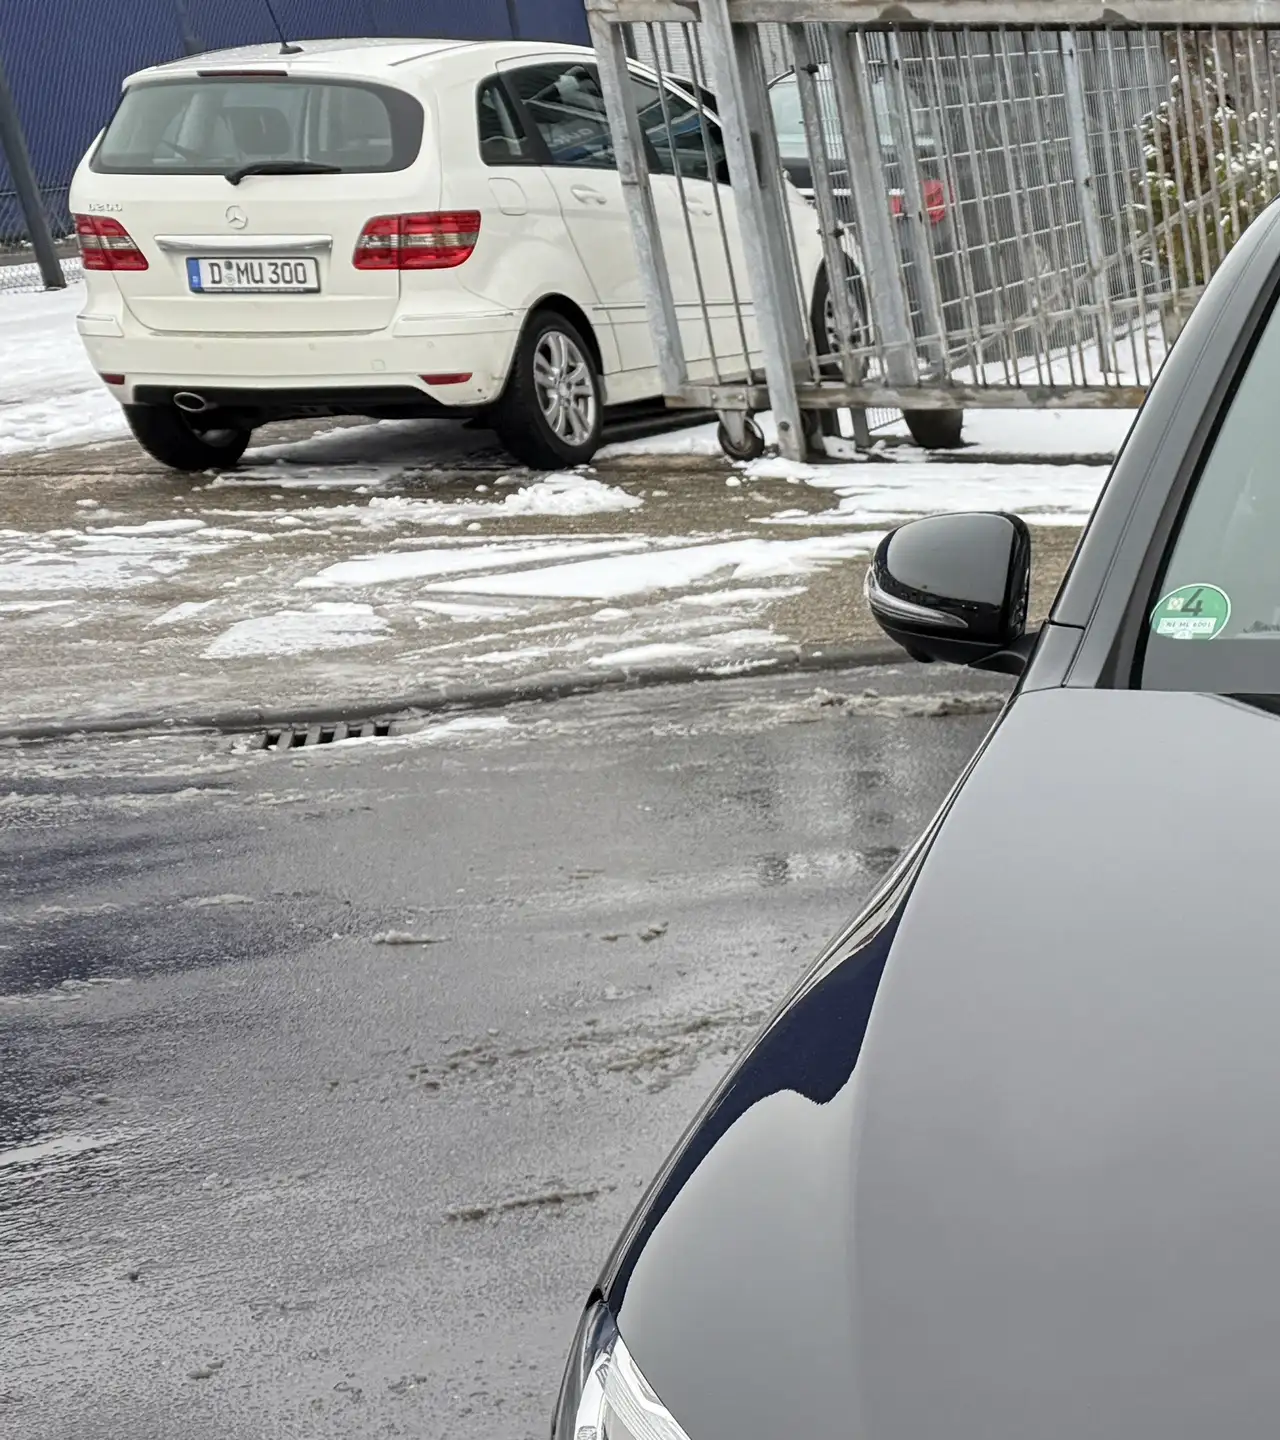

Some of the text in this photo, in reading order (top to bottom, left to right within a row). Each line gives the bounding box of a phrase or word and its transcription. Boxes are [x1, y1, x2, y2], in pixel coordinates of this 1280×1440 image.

[208, 261, 308, 285] D MU 300
[1180, 587, 1205, 617] 4
